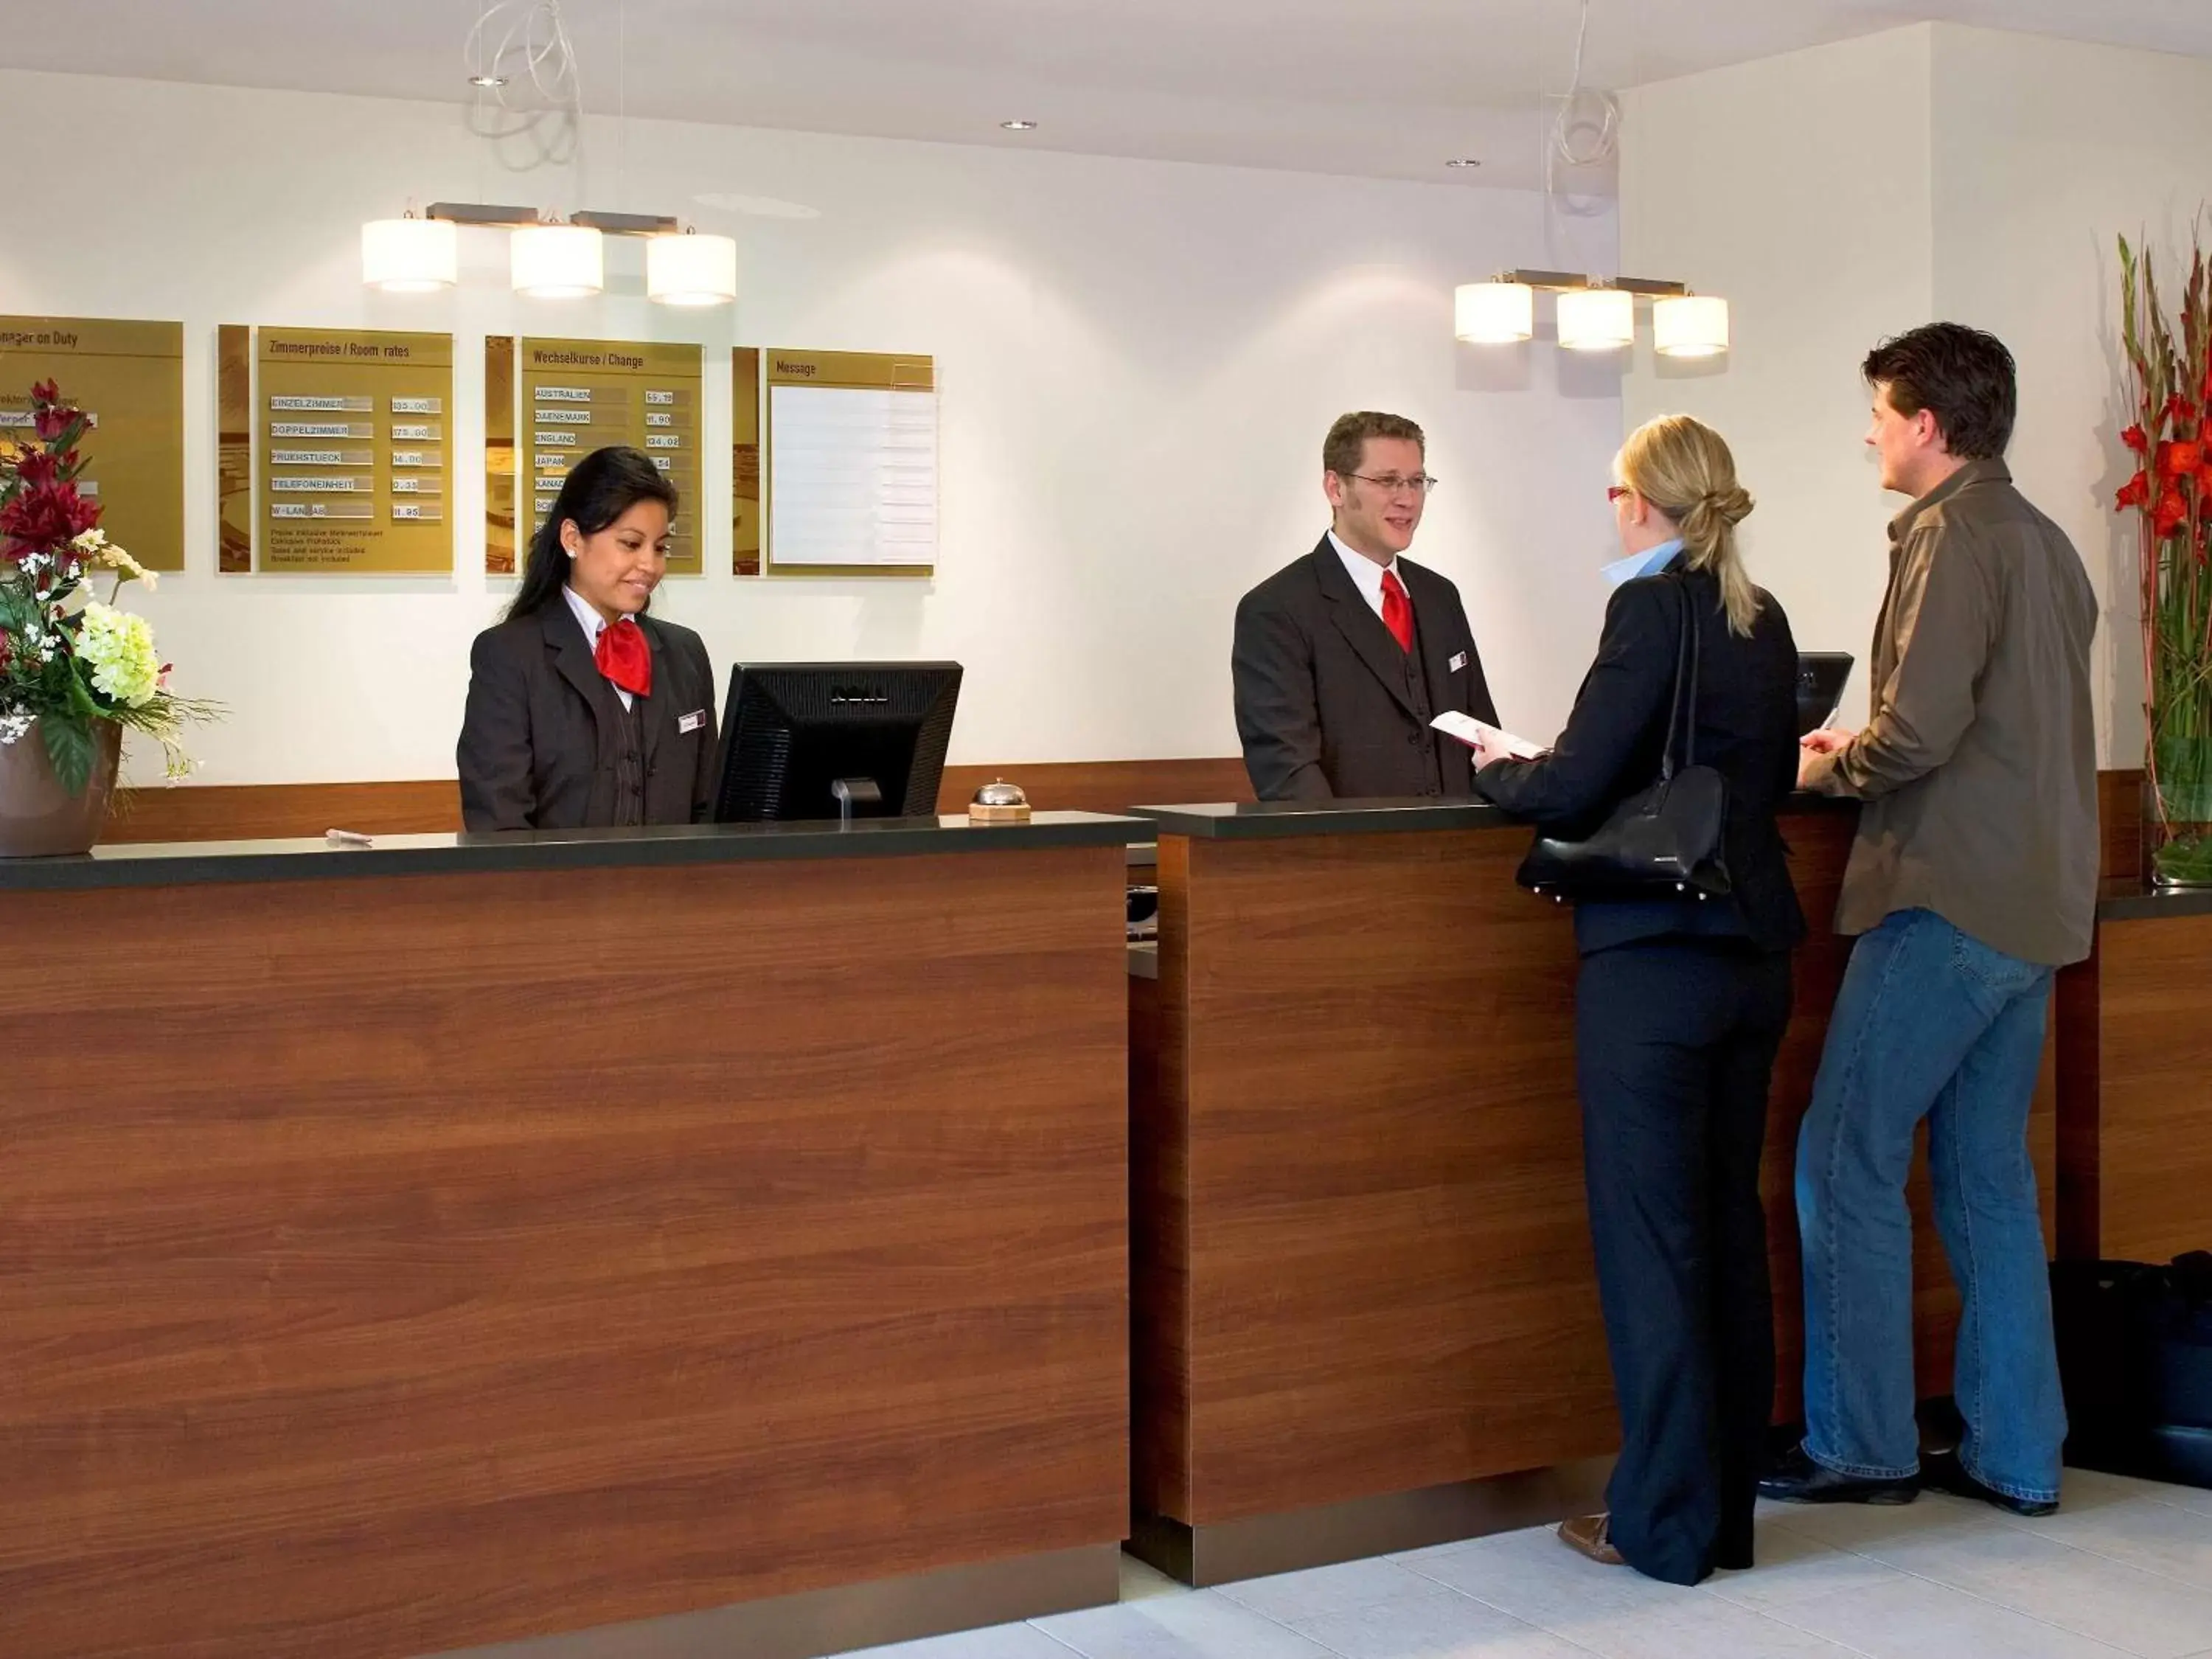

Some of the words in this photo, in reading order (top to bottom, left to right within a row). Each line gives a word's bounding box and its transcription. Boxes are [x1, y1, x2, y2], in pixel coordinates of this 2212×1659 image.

[0, 332, 33, 347] nager
[37, 333, 50, 344] on
[53, 331, 77, 349] Duty
[270, 341, 341, 357] Zimmerpreise
[343, 342, 347, 355] /
[350, 343, 379, 356] Room
[384, 344, 409, 357] rates
[534, 350, 601, 365] Wechselkurse
[608, 353, 644, 369] Change
[776, 361, 816, 377] Message
[272, 397, 344, 408] EINZELZIMMER
[272, 424, 348, 434] DOPPELZIMMER
[273, 479, 354, 489] TELEFONEINHEIT
